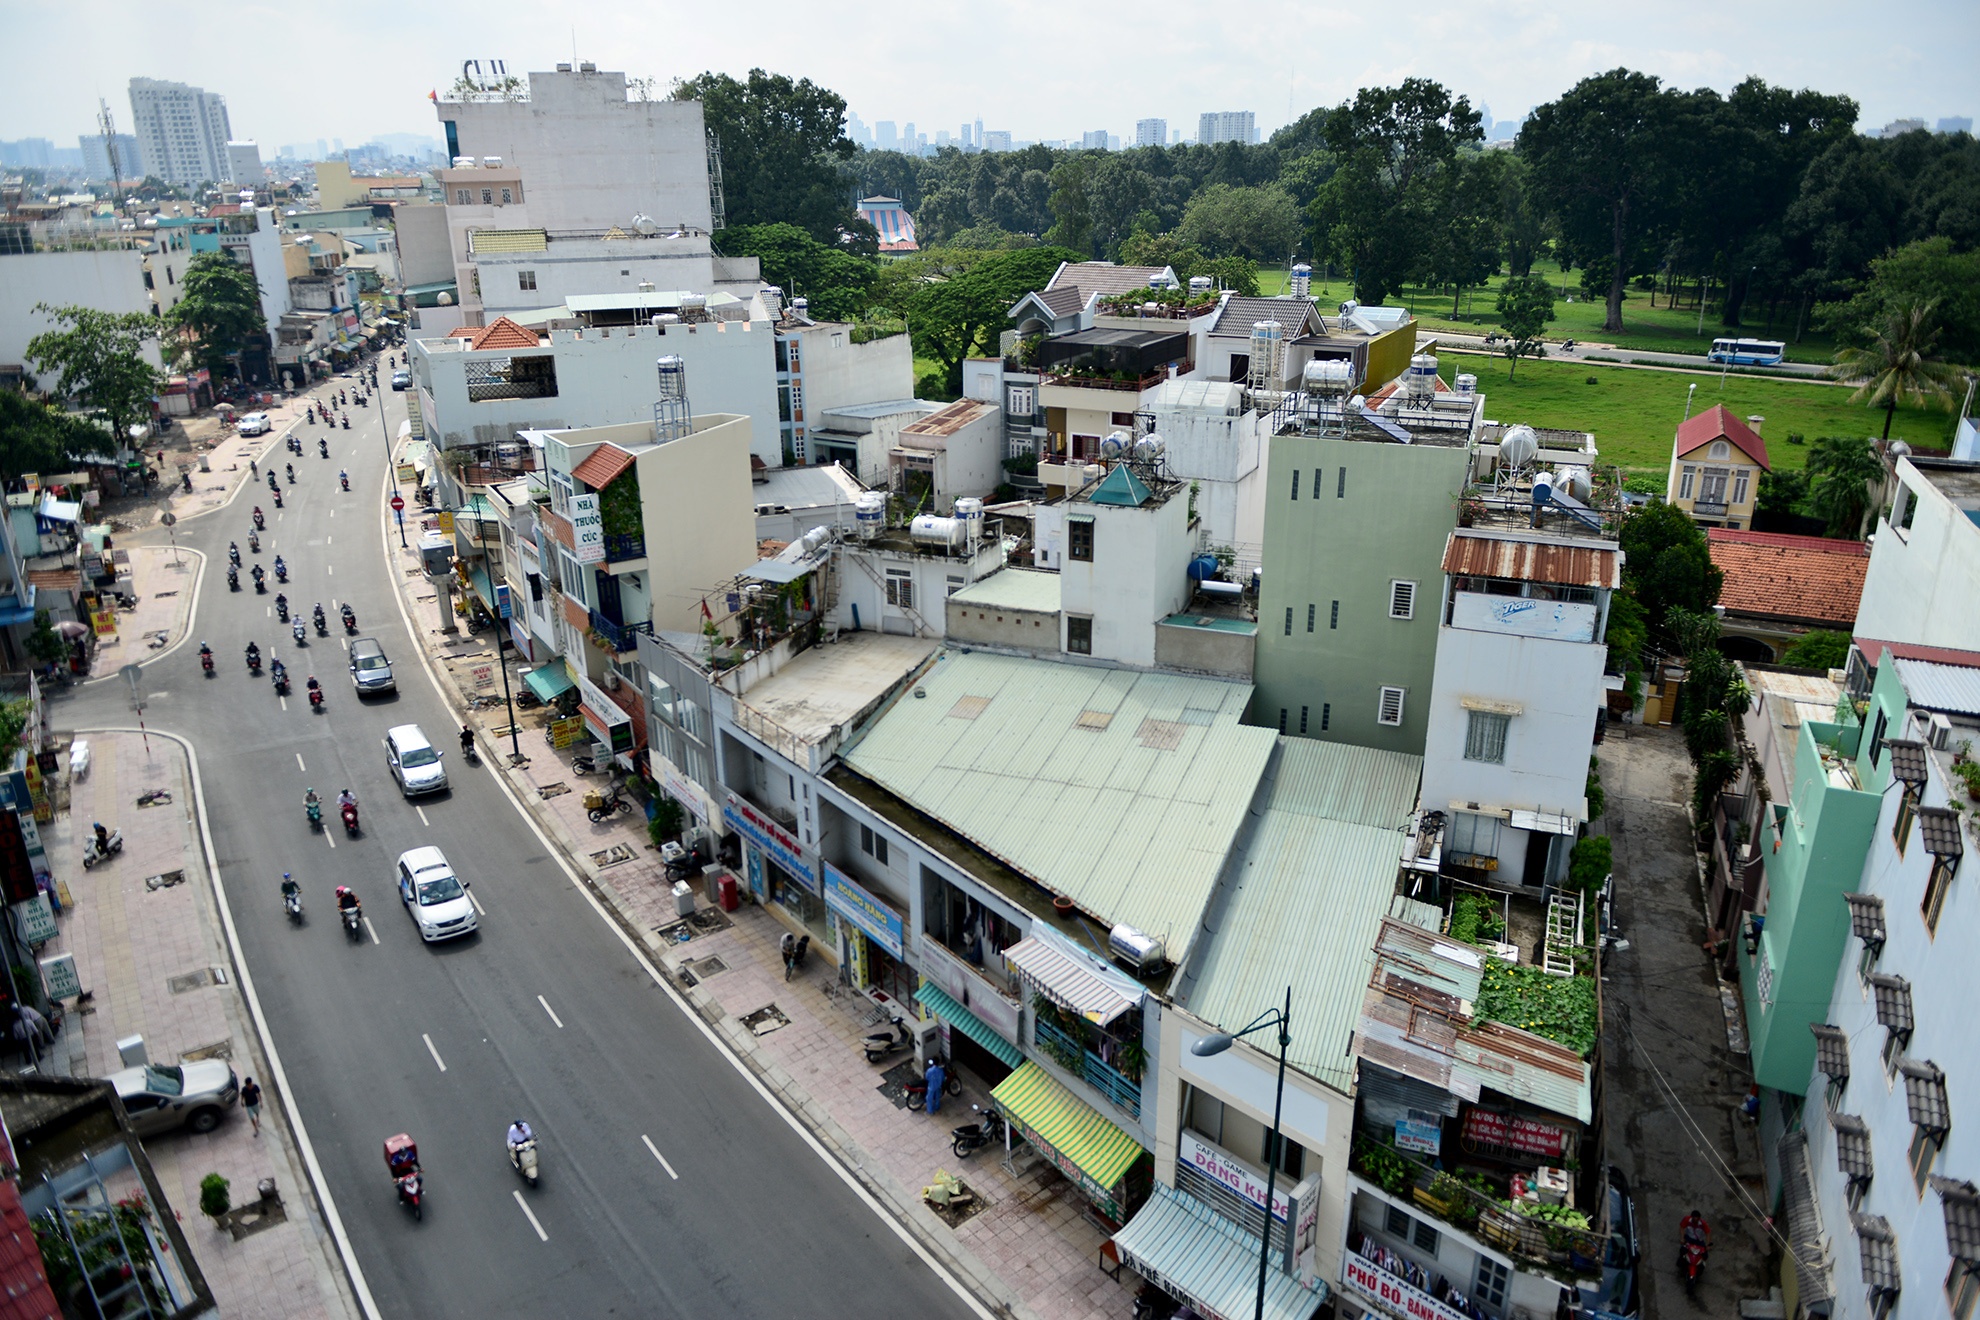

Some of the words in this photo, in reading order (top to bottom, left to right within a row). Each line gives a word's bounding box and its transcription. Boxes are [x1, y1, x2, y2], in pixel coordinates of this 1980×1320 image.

[576, 497, 594, 510] NHÀ
[575, 510, 600, 527] THUỐC
[1504, 601, 1536, 613] TIGER
[97, 624, 114, 633] GAME
[1196, 1144, 1216, 1159] CAFÉ
[1224, 1160, 1248, 1179] GAME
[1140, 1263, 1159, 1285] PHÊ
[1164, 1280, 1196, 1311] GAME
[1348, 1263, 1377, 1290] PHỞ
[1380, 1282, 1402, 1305] BÒ
